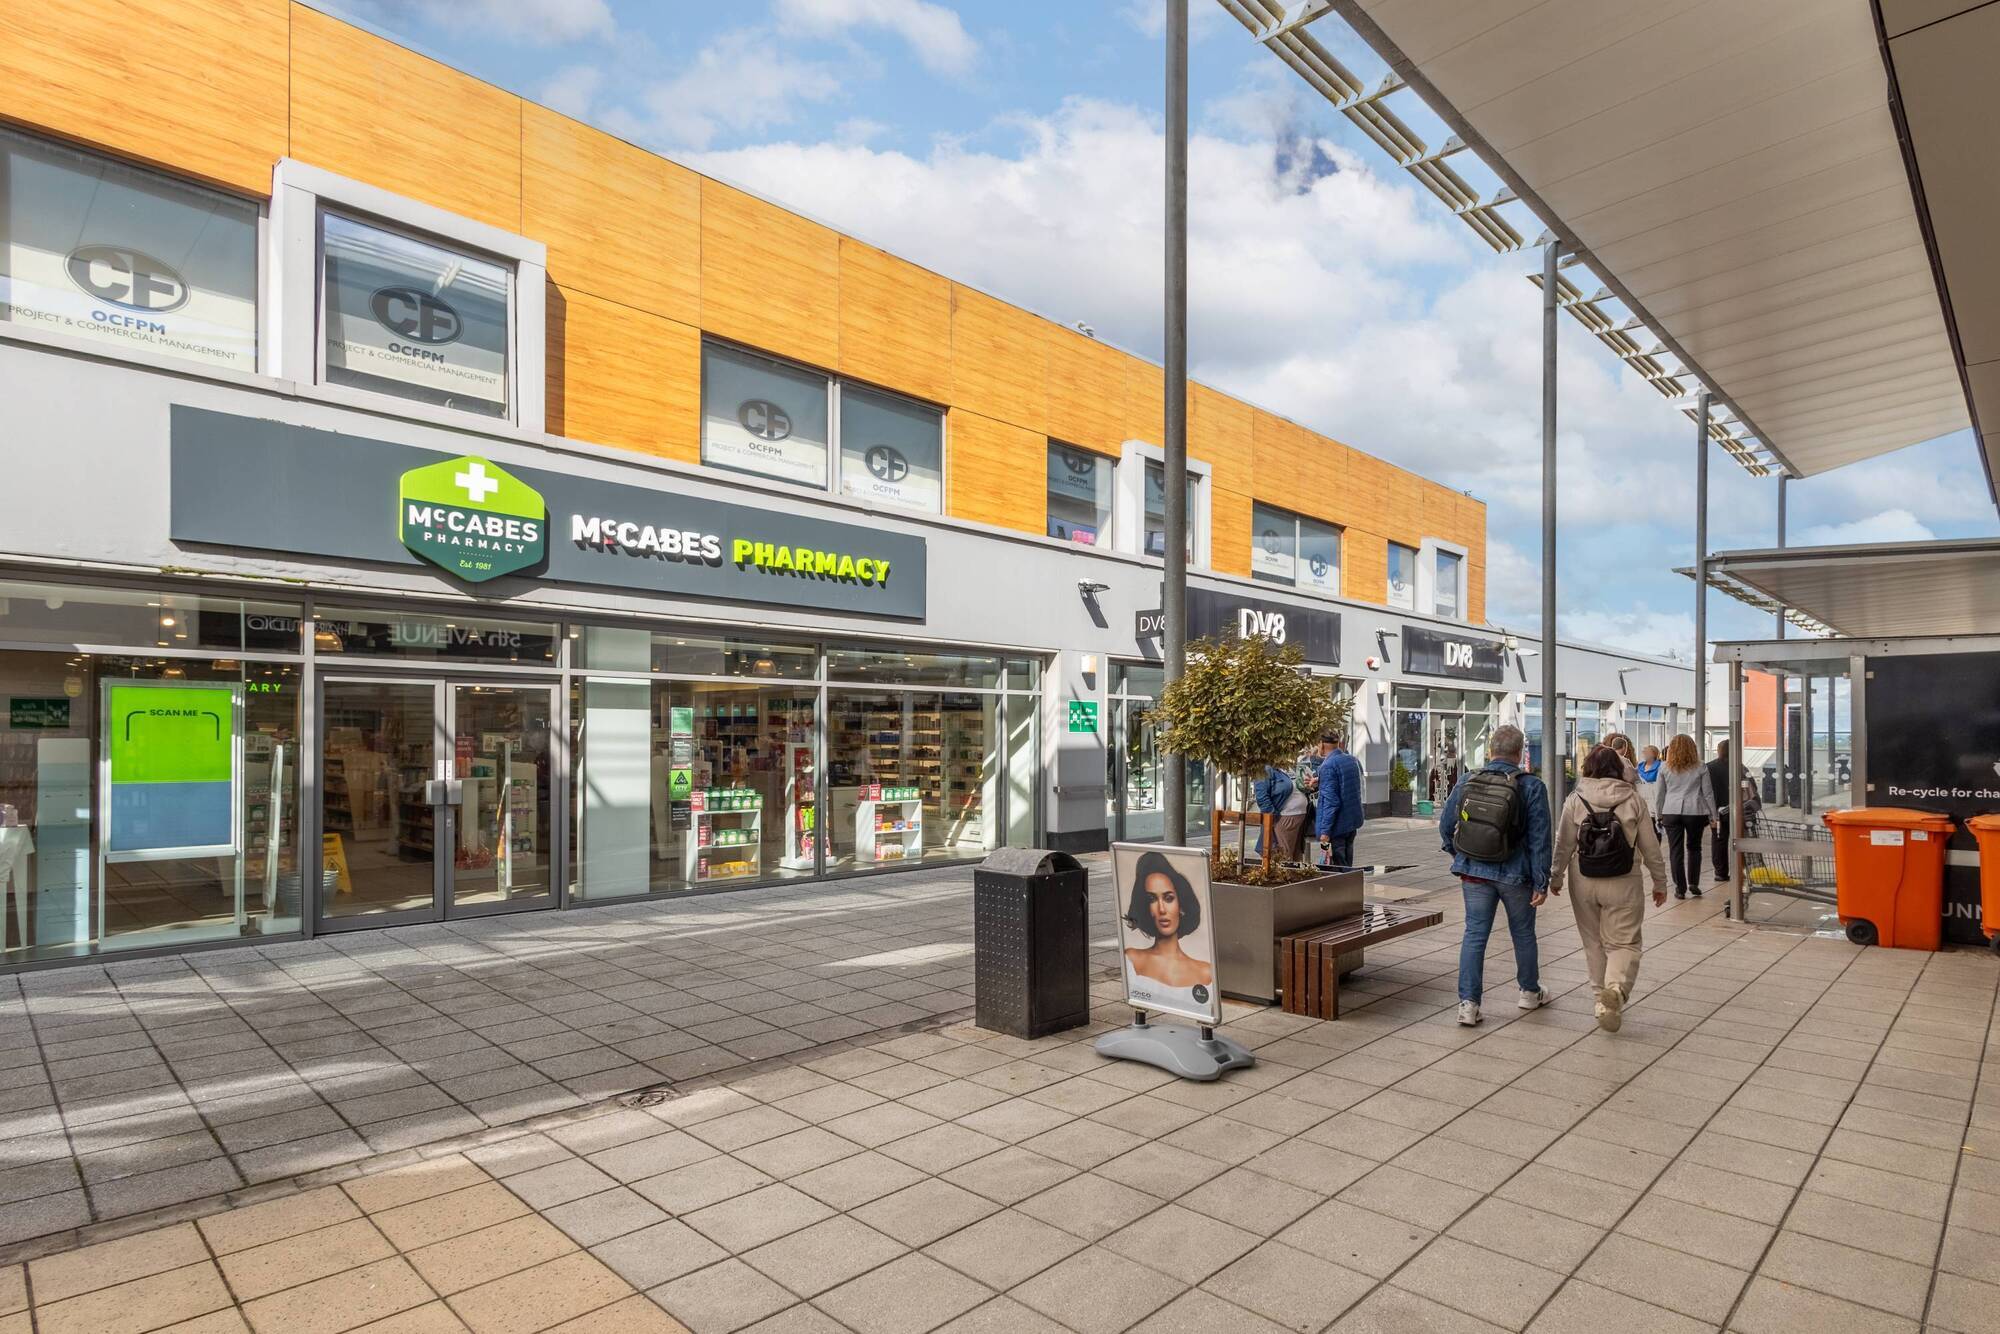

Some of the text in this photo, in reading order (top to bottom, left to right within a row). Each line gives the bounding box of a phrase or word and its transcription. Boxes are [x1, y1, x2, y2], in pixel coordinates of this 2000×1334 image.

[8, 304, 238, 361] PROJECT & COMMERCIAL MANAGEMENT
[91, 309, 166, 335] OCFPM
[327, 338, 497, 386] PROJECT & COMMERCIAL MANAGEMENT
[388, 342, 445, 364] OCFPM
[748, 442, 782, 457] OCFPM
[872, 484, 900, 497] OCFPM
[424, 531, 525, 554] PHARMACY
[459, 559, 492, 571] Est 1981
[733, 538, 890, 583] PHARMACY
[1238, 607, 1286, 645] DV8
[1443, 641, 1474, 669] DV8
[149, 708, 199, 718] SCAN ME
[1888, 786, 1949, 799] Re-cycle
[1951, 787, 1972, 798] for
